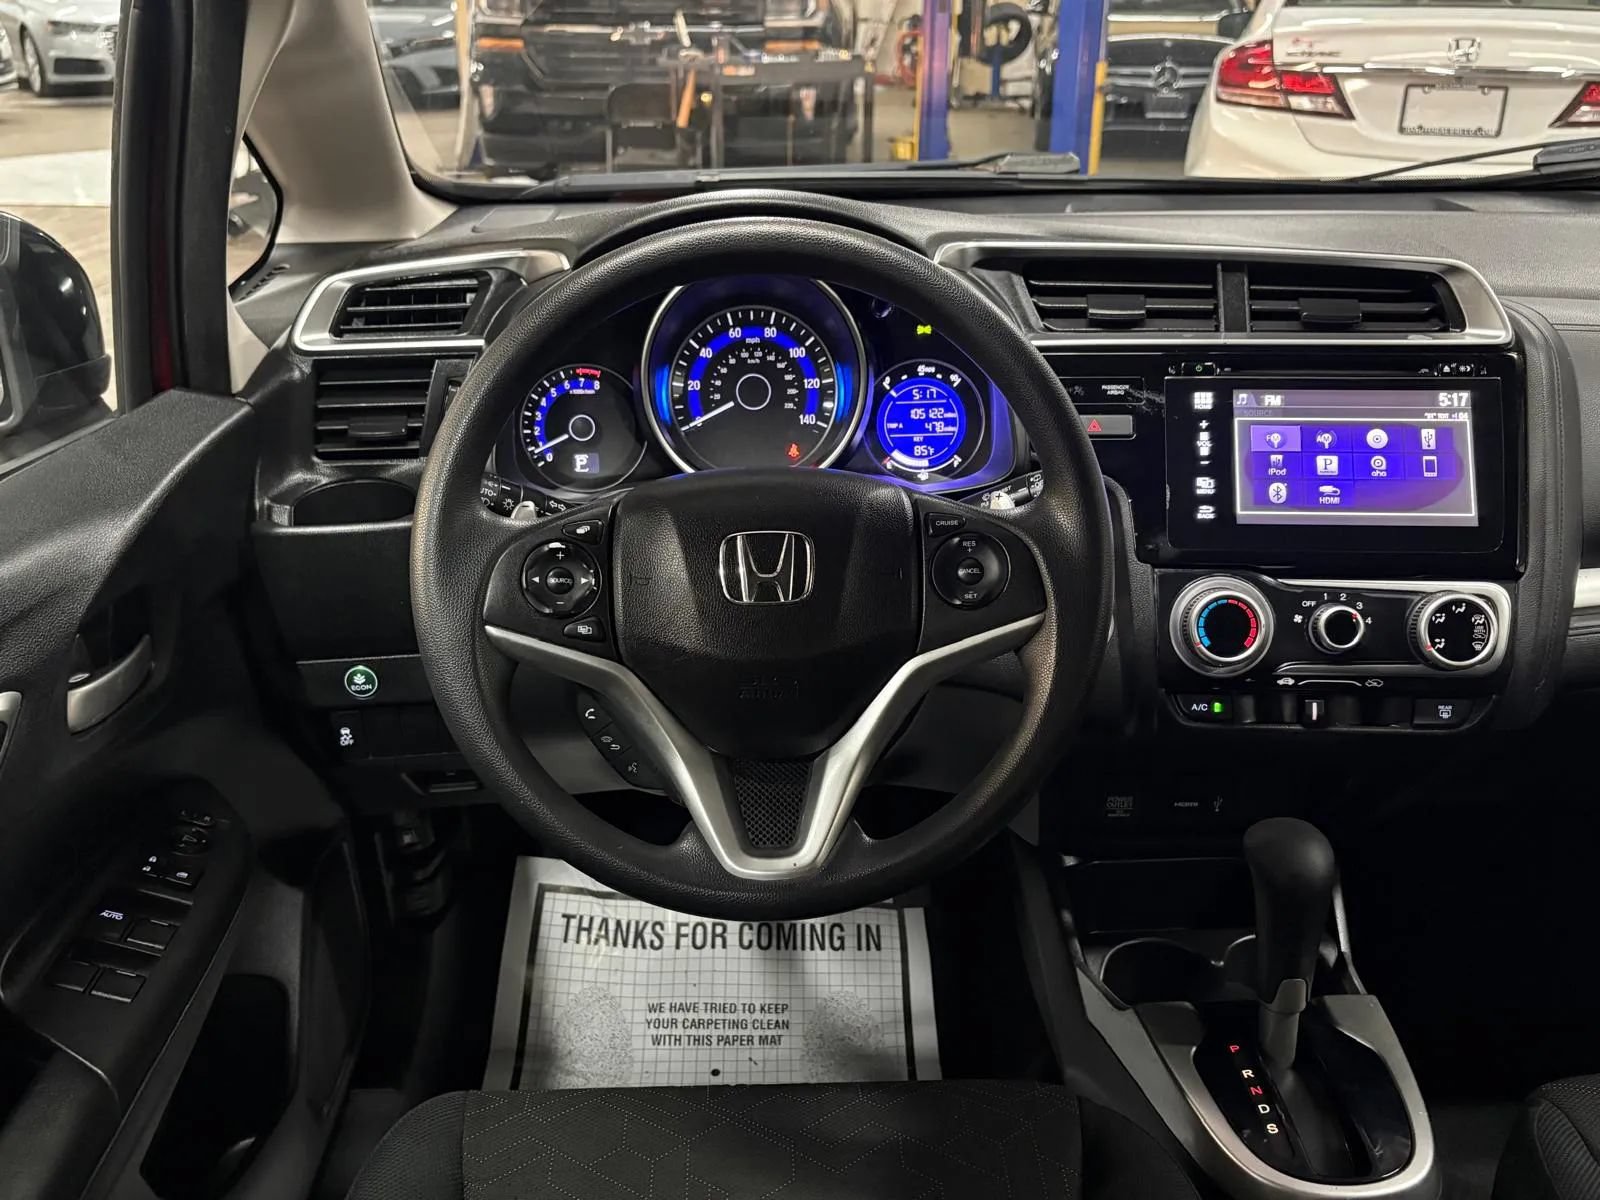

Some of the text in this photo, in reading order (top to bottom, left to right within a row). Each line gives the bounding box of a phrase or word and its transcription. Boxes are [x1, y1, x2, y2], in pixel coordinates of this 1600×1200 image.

[729, 327, 741, 338] 60
[764, 327, 777, 338] 80
[700, 347, 712, 358] 40
[789, 347, 806, 358] 100
[563, 380, 571, 390] 6
[579, 378, 585, 388] 7
[593, 380, 601, 390] 8
[688, 380, 700, 391] 20
[804, 378, 820, 389] 120
[550, 388, 557, 397] 5
[912, 389, 937, 400] 5:17
[540, 397, 547, 407] 4
[1264, 393, 1469, 407] FM 5:17
[535, 411, 542, 421] 3
[799, 414, 816, 425] 140
[534, 426, 541, 436] 2
[545, 453, 553, 462] 0
[575, 454, 589, 472] P
[1268, 468, 1287, 476] iPod
[1371, 469, 1387, 477] aha
[1319, 497, 1341, 505] HDMI
[1323, 592, 1328, 600] 1
[1339, 592, 1347, 601] 2
[1356, 601, 1363, 610] 3
[1365, 616, 1373, 625] 4
[1191, 703, 1208, 711] A/C
[99, 910, 124, 920] AUTO
[561, 913, 882, 951] THANKS FOR COMING IN
[647, 1002, 789, 1014] WE HAVE TRIED TO KEEP
[646, 1018, 789, 1030] YOUR CARPETING CLEAN
[651, 1034, 784, 1046] WITH THIS PAPER MAT
[1229, 1045, 1240, 1053] P
[1241, 1069, 1255, 1079] R
[1250, 1085, 1263, 1095] N
[1257, 1104, 1270, 1114] D
[1266, 1123, 1279, 1134] S
